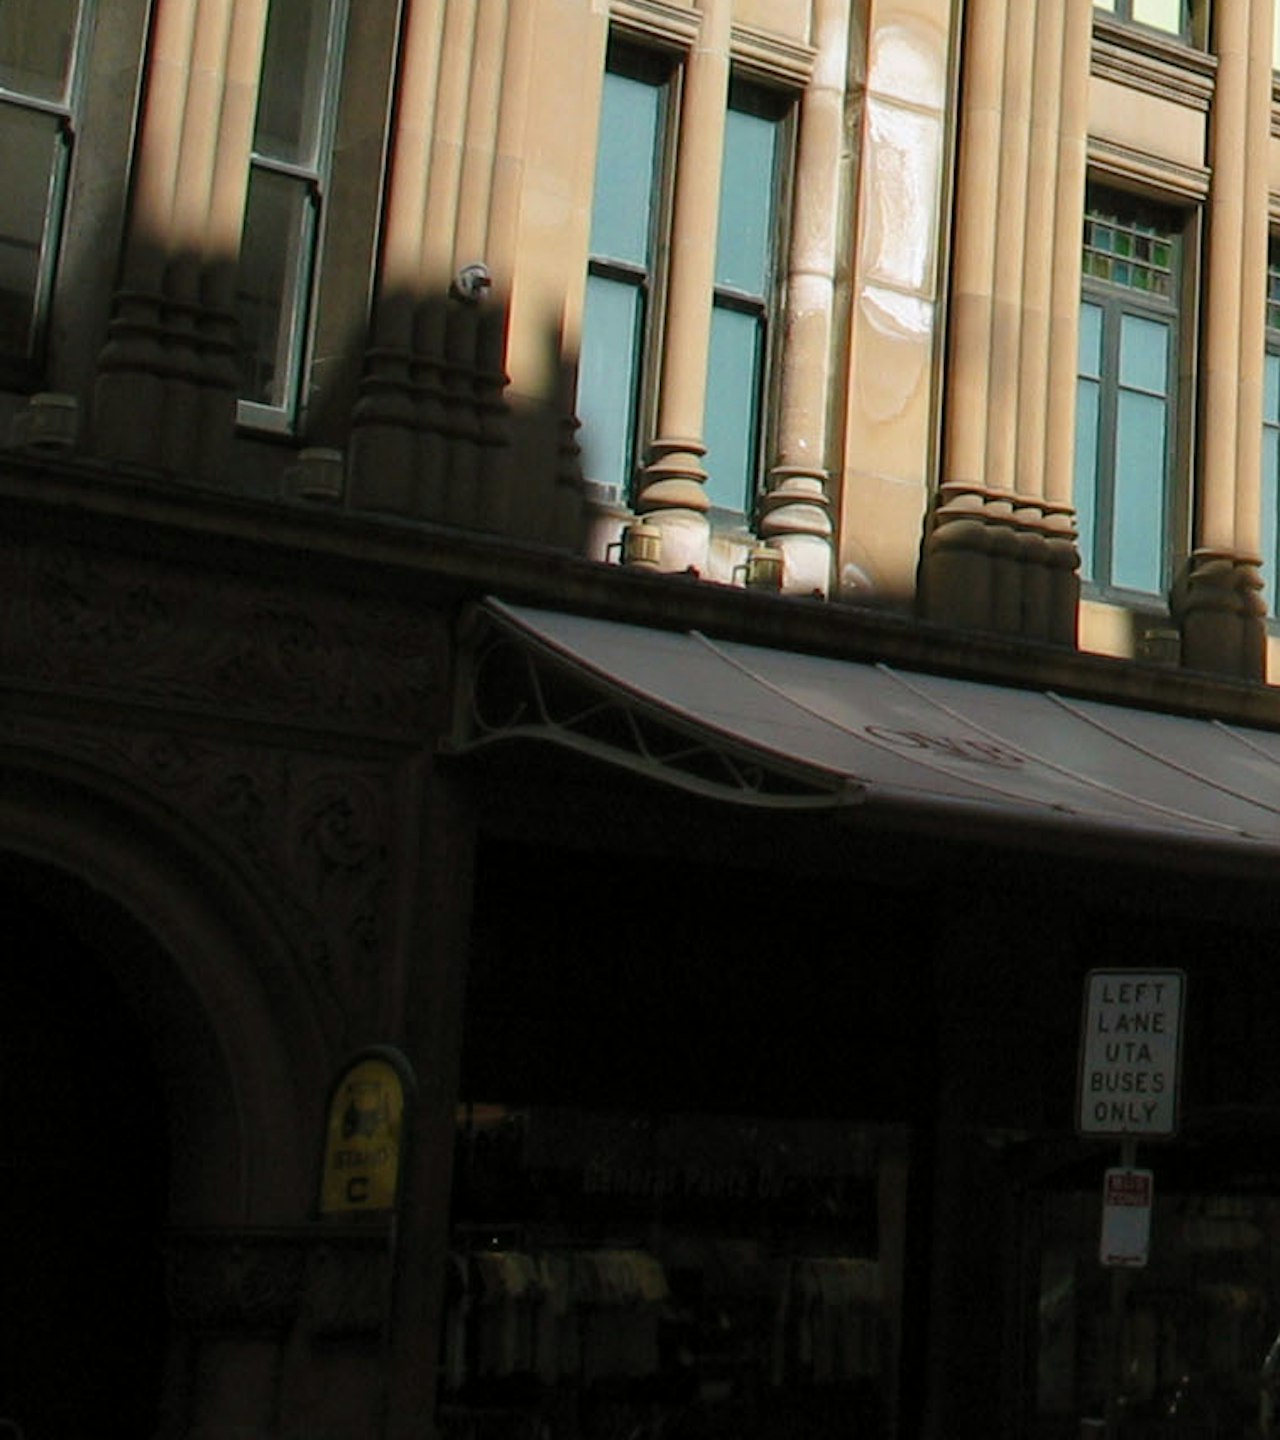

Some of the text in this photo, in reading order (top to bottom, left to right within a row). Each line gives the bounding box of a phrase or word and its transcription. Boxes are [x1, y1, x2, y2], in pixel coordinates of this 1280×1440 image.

[1101, 981, 1168, 1005] LEFT
[1097, 1012, 1166, 1034] LANE
[1105, 1042, 1152, 1063] UTA
[1090, 1071, 1165, 1093] BUSES
[1094, 1101, 1160, 1124] ONLY
